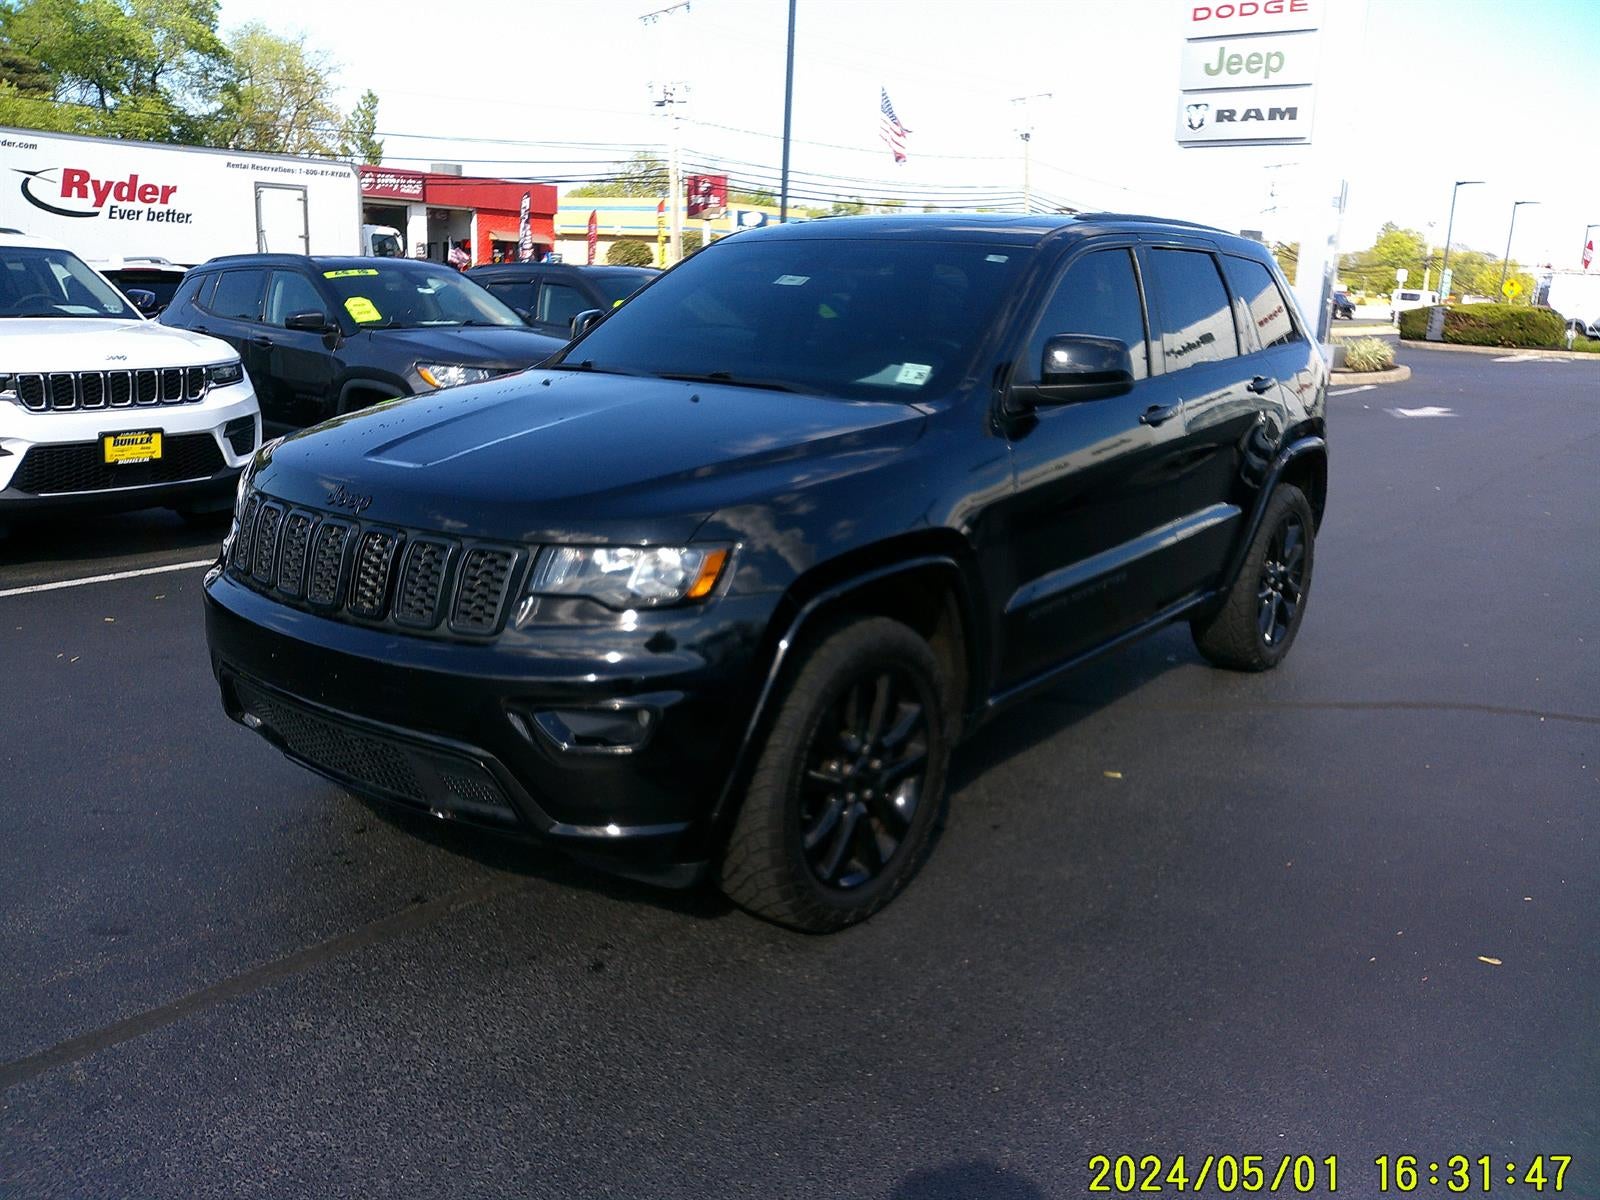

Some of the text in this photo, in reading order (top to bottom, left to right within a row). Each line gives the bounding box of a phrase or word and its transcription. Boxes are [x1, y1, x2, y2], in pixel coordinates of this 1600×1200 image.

[1193, 0, 1309, 21] DODGE
[1204, 46, 1285, 79] Jeep
[1215, 107, 1298, 123] RAM
[0, 139, 38, 150] der.com
[226, 161, 250, 170] Rental
[60, 168, 177, 208] Ryder
[108, 205, 193, 224] Ever better.
[113, 436, 153, 446] BUHLER
